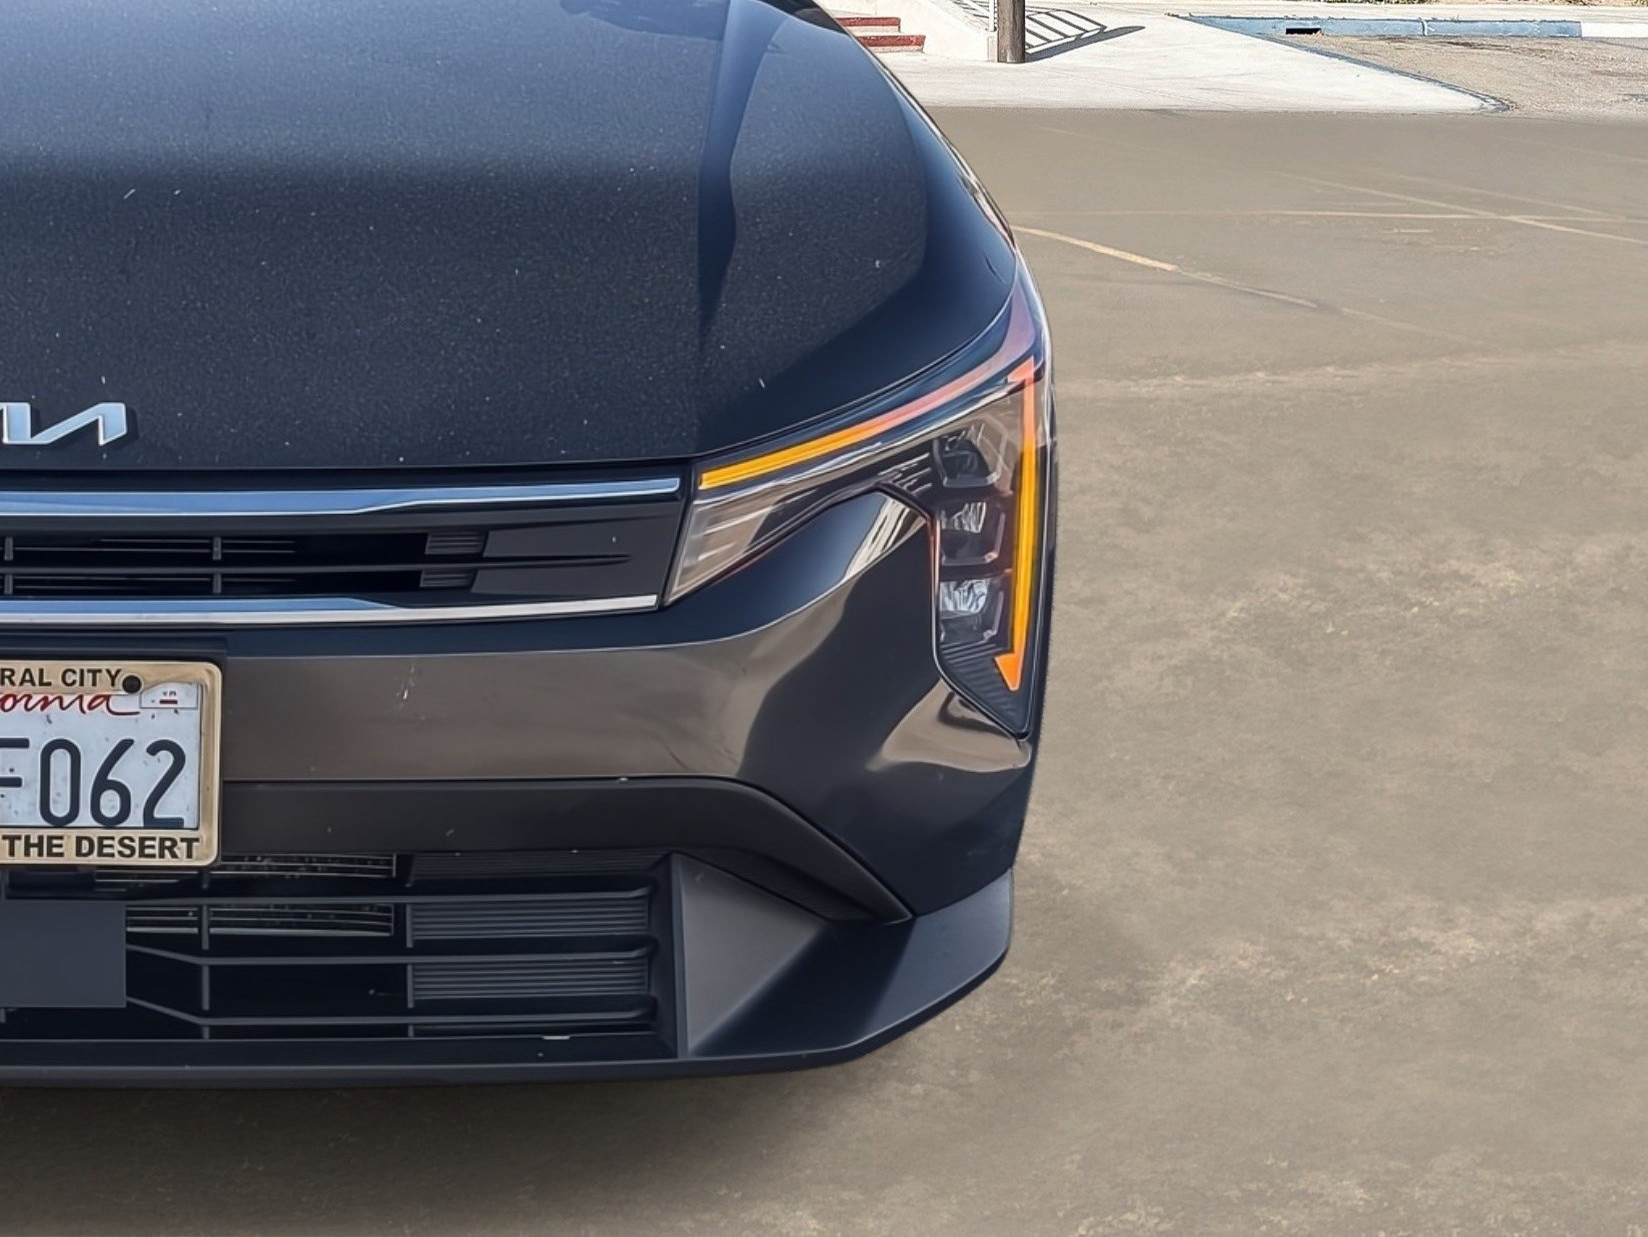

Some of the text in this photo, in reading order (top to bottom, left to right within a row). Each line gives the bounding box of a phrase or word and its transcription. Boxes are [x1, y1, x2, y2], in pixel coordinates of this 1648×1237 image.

[60, 668, 123, 687] CITY
[2, 834, 65, 858] THE
[75, 835, 200, 860] DESERT
